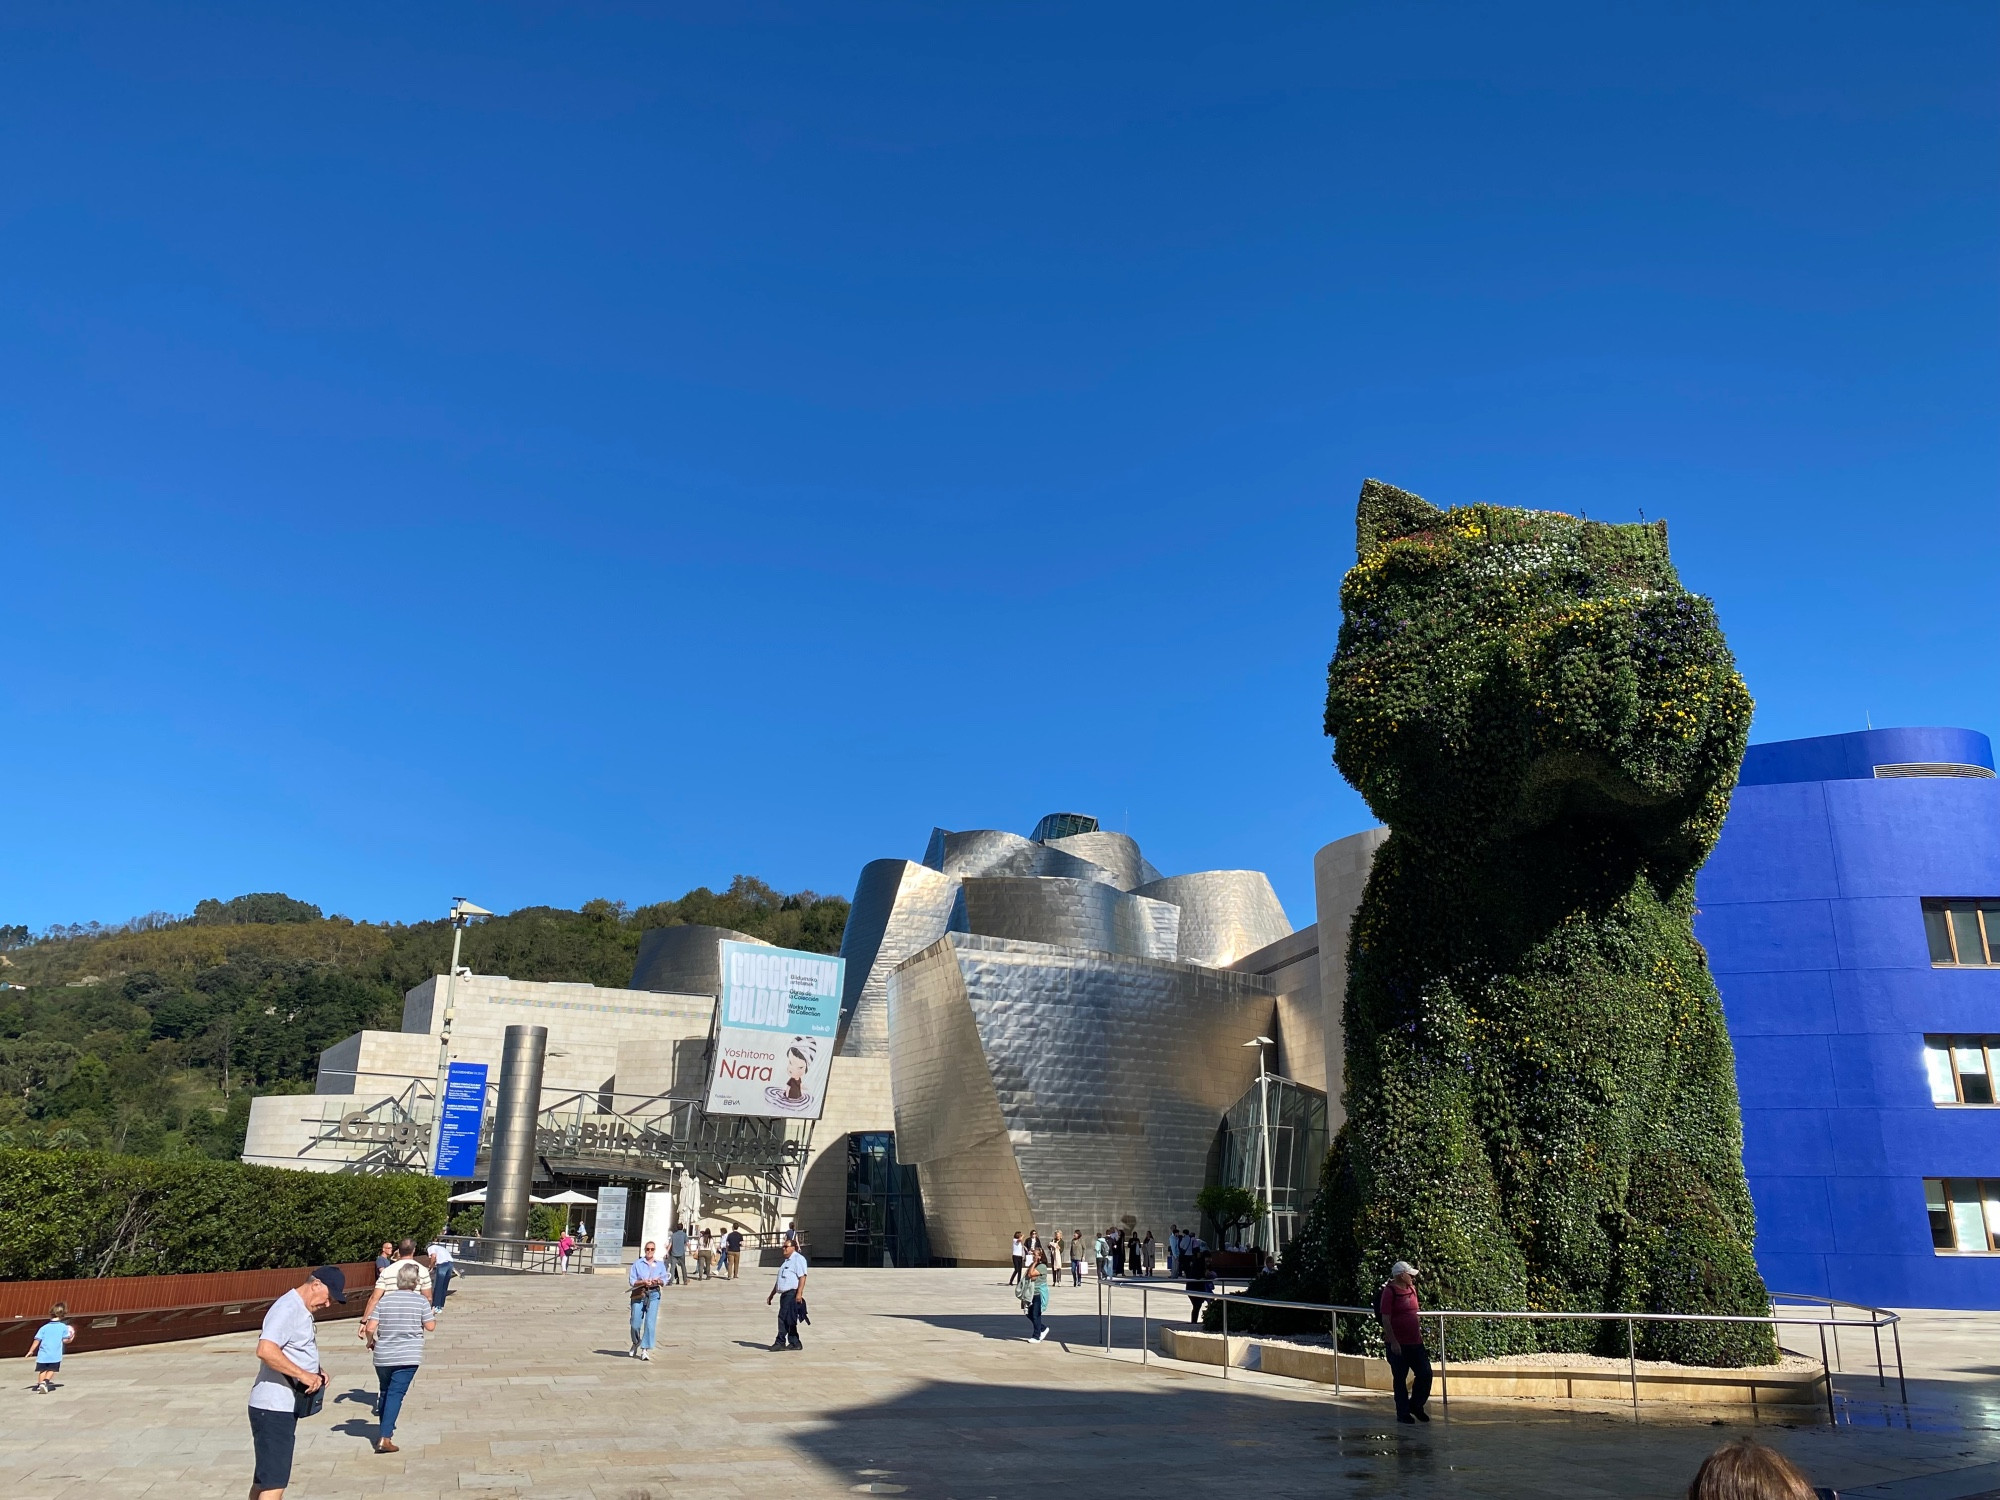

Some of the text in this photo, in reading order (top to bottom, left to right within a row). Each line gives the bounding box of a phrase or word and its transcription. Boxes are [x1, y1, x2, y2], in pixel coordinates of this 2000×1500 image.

[731, 952, 838, 997] GUGGENHEIM
[728, 985, 790, 1028] BILBAO
[724, 1047, 775, 1061] Yoshitomo
[719, 1058, 773, 1082] Nara
[579, 1122, 674, 1152] Bilbao
